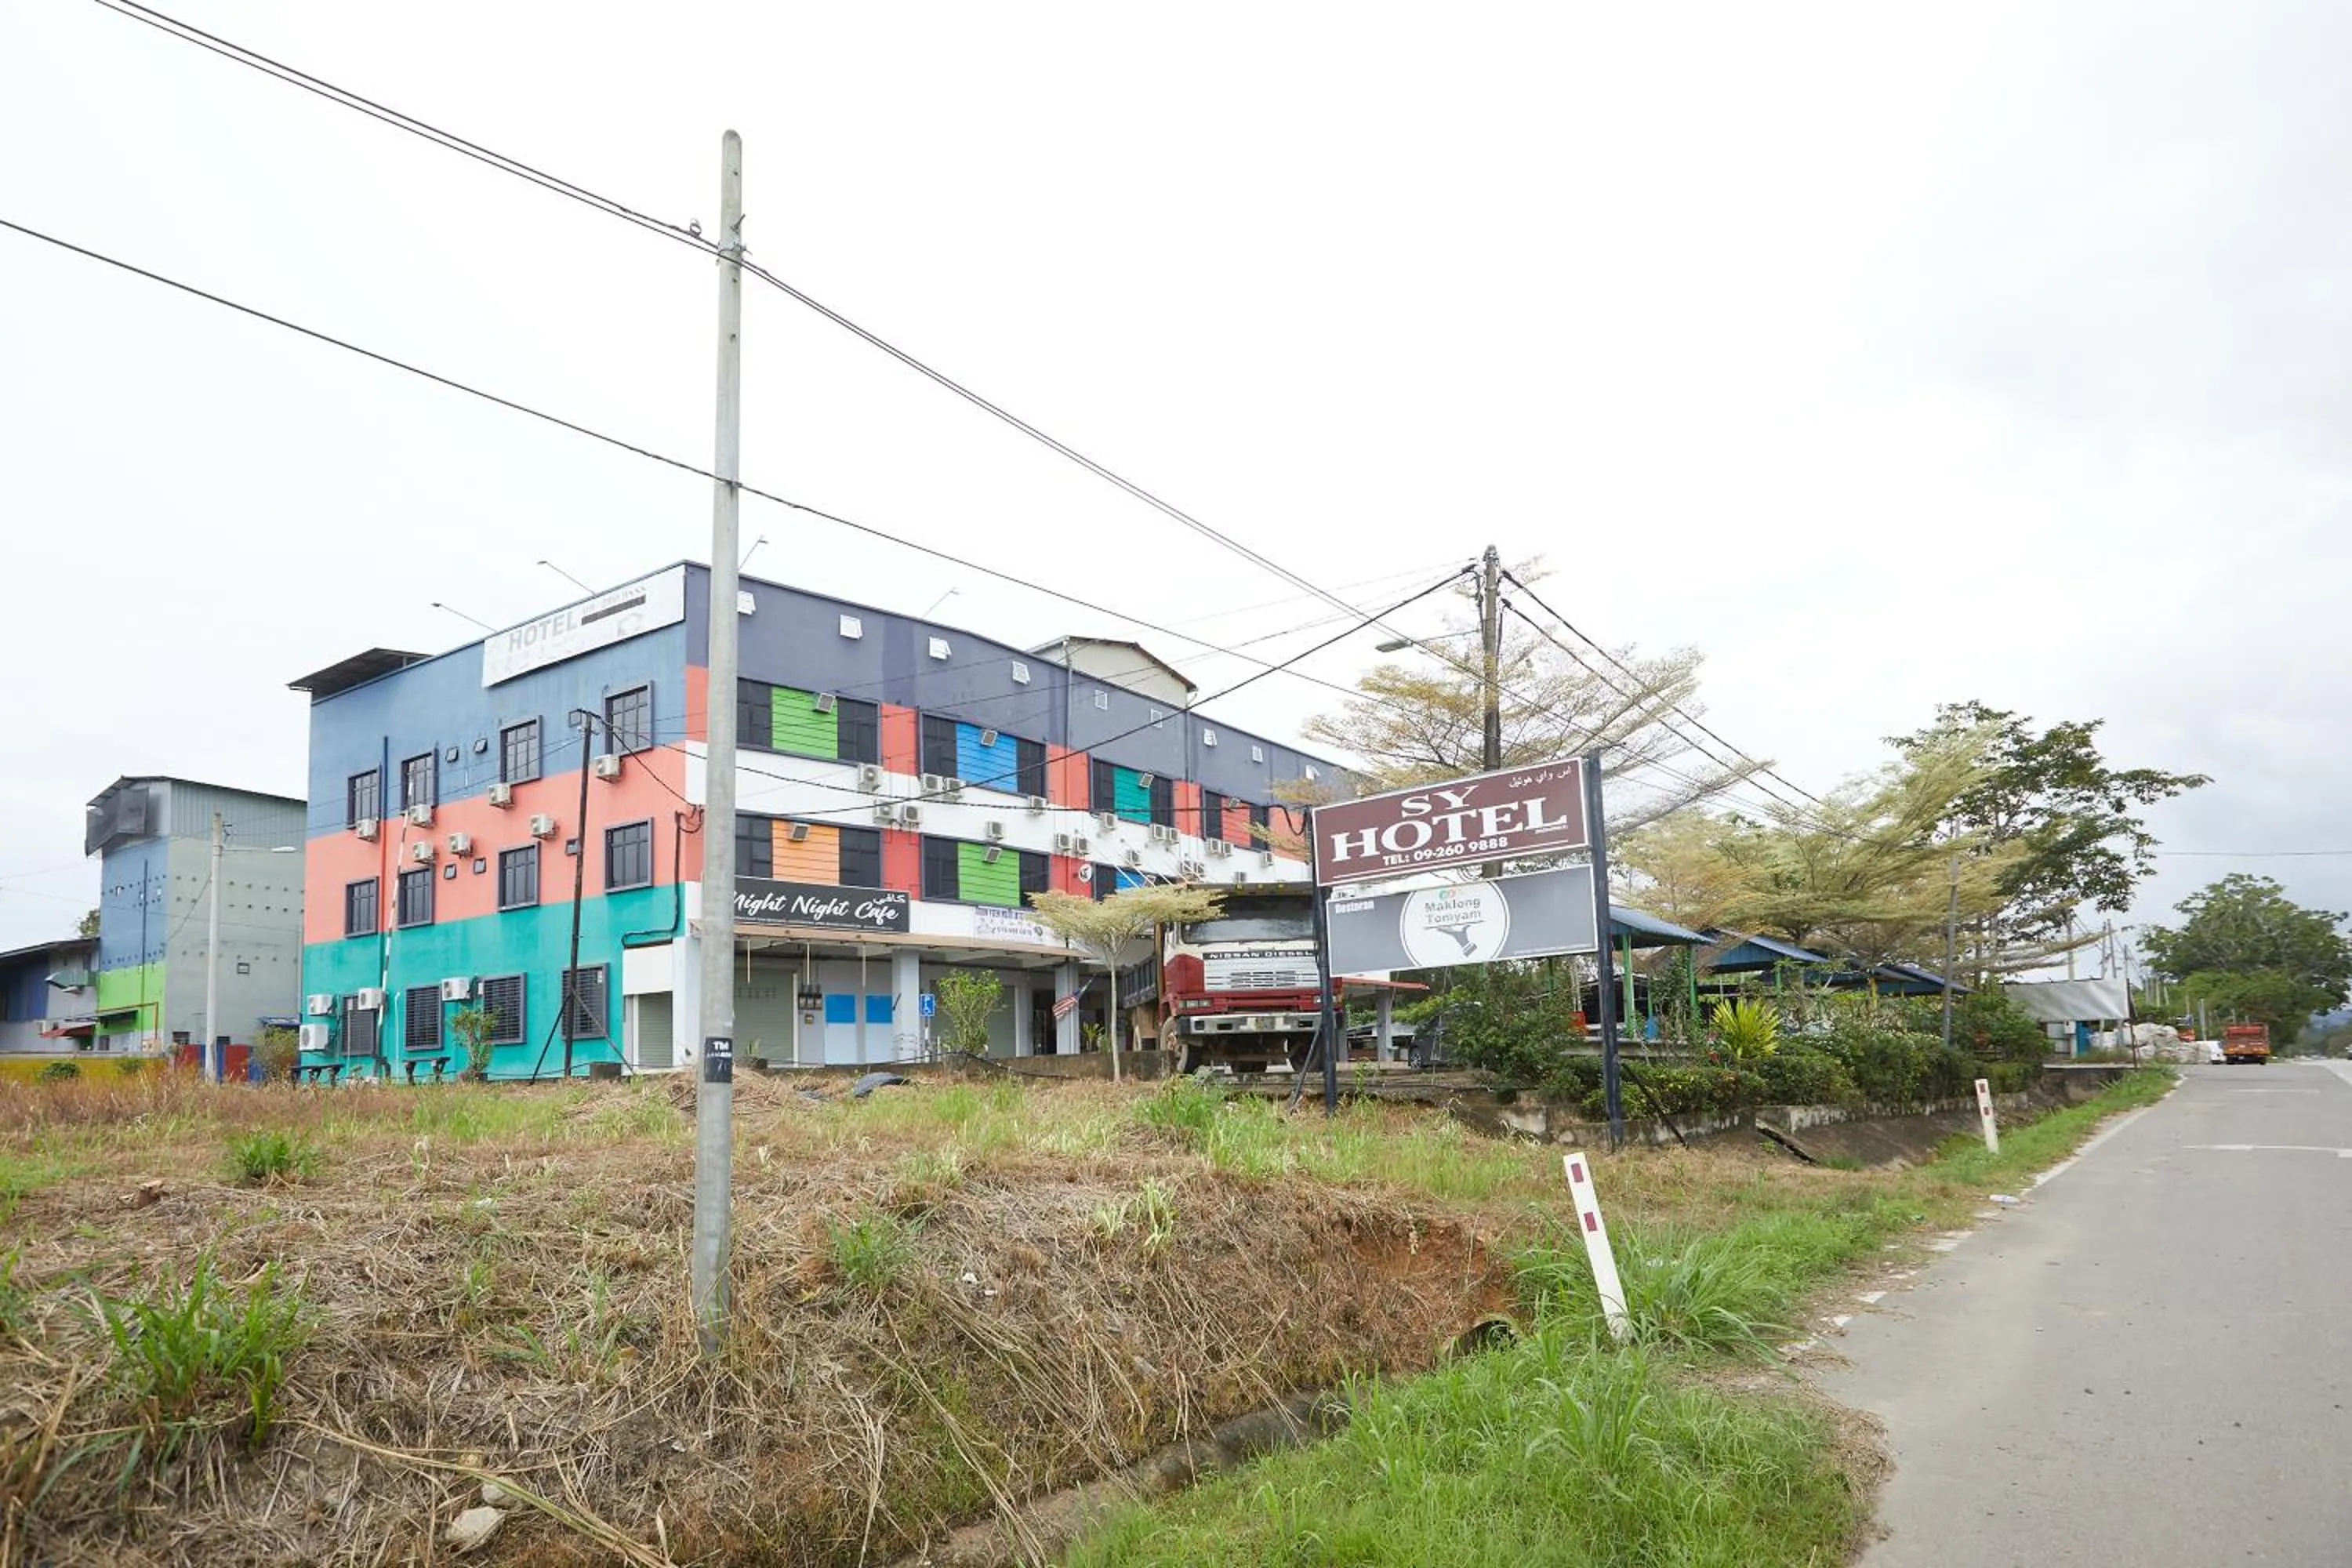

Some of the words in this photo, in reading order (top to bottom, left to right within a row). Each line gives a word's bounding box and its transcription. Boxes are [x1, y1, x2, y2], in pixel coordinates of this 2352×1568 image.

[508, 611, 579, 652] HOTEL
[1402, 785, 1479, 818] SY
[1330, 797, 1567, 862] HOTEL
[1383, 855, 1410, 866] TEL:
[1414, 844, 1465, 861] 09-260
[1468, 837, 1508, 852] 9888
[732, 891, 786, 916] Night
[790, 895, 849, 920] Night
[854, 902, 900, 926] Cafe
[1425, 898, 1480, 913] Maklong
[1425, 911, 1481, 923] Tomyam
[713, 1040, 729, 1051] TM
